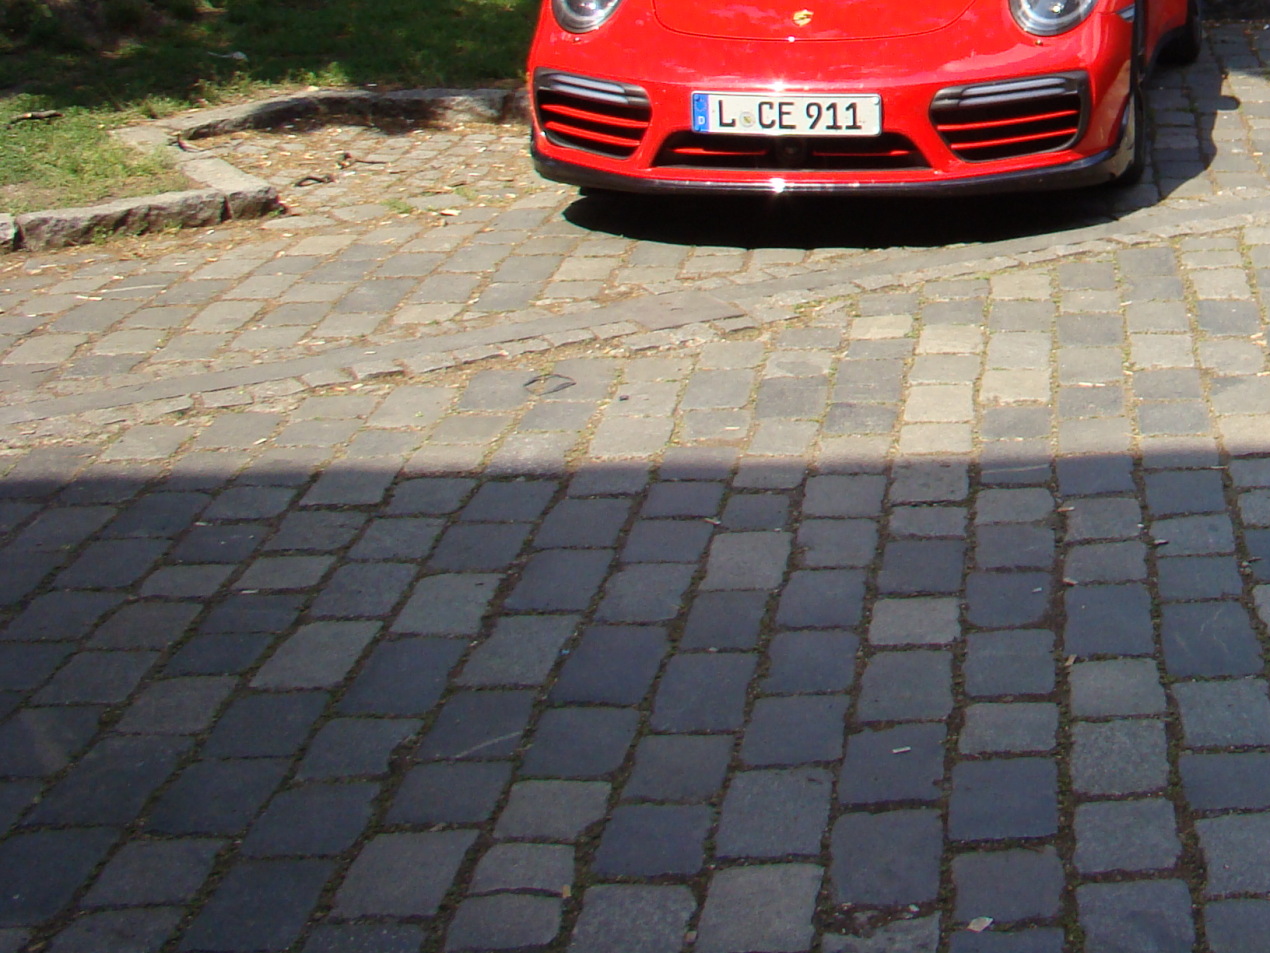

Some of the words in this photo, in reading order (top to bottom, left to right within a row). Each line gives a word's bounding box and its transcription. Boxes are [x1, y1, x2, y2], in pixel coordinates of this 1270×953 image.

[697, 116, 706, 125] D
[718, 99, 737, 128] L
[758, 101, 797, 131] CE
[805, 102, 863, 131] 911
